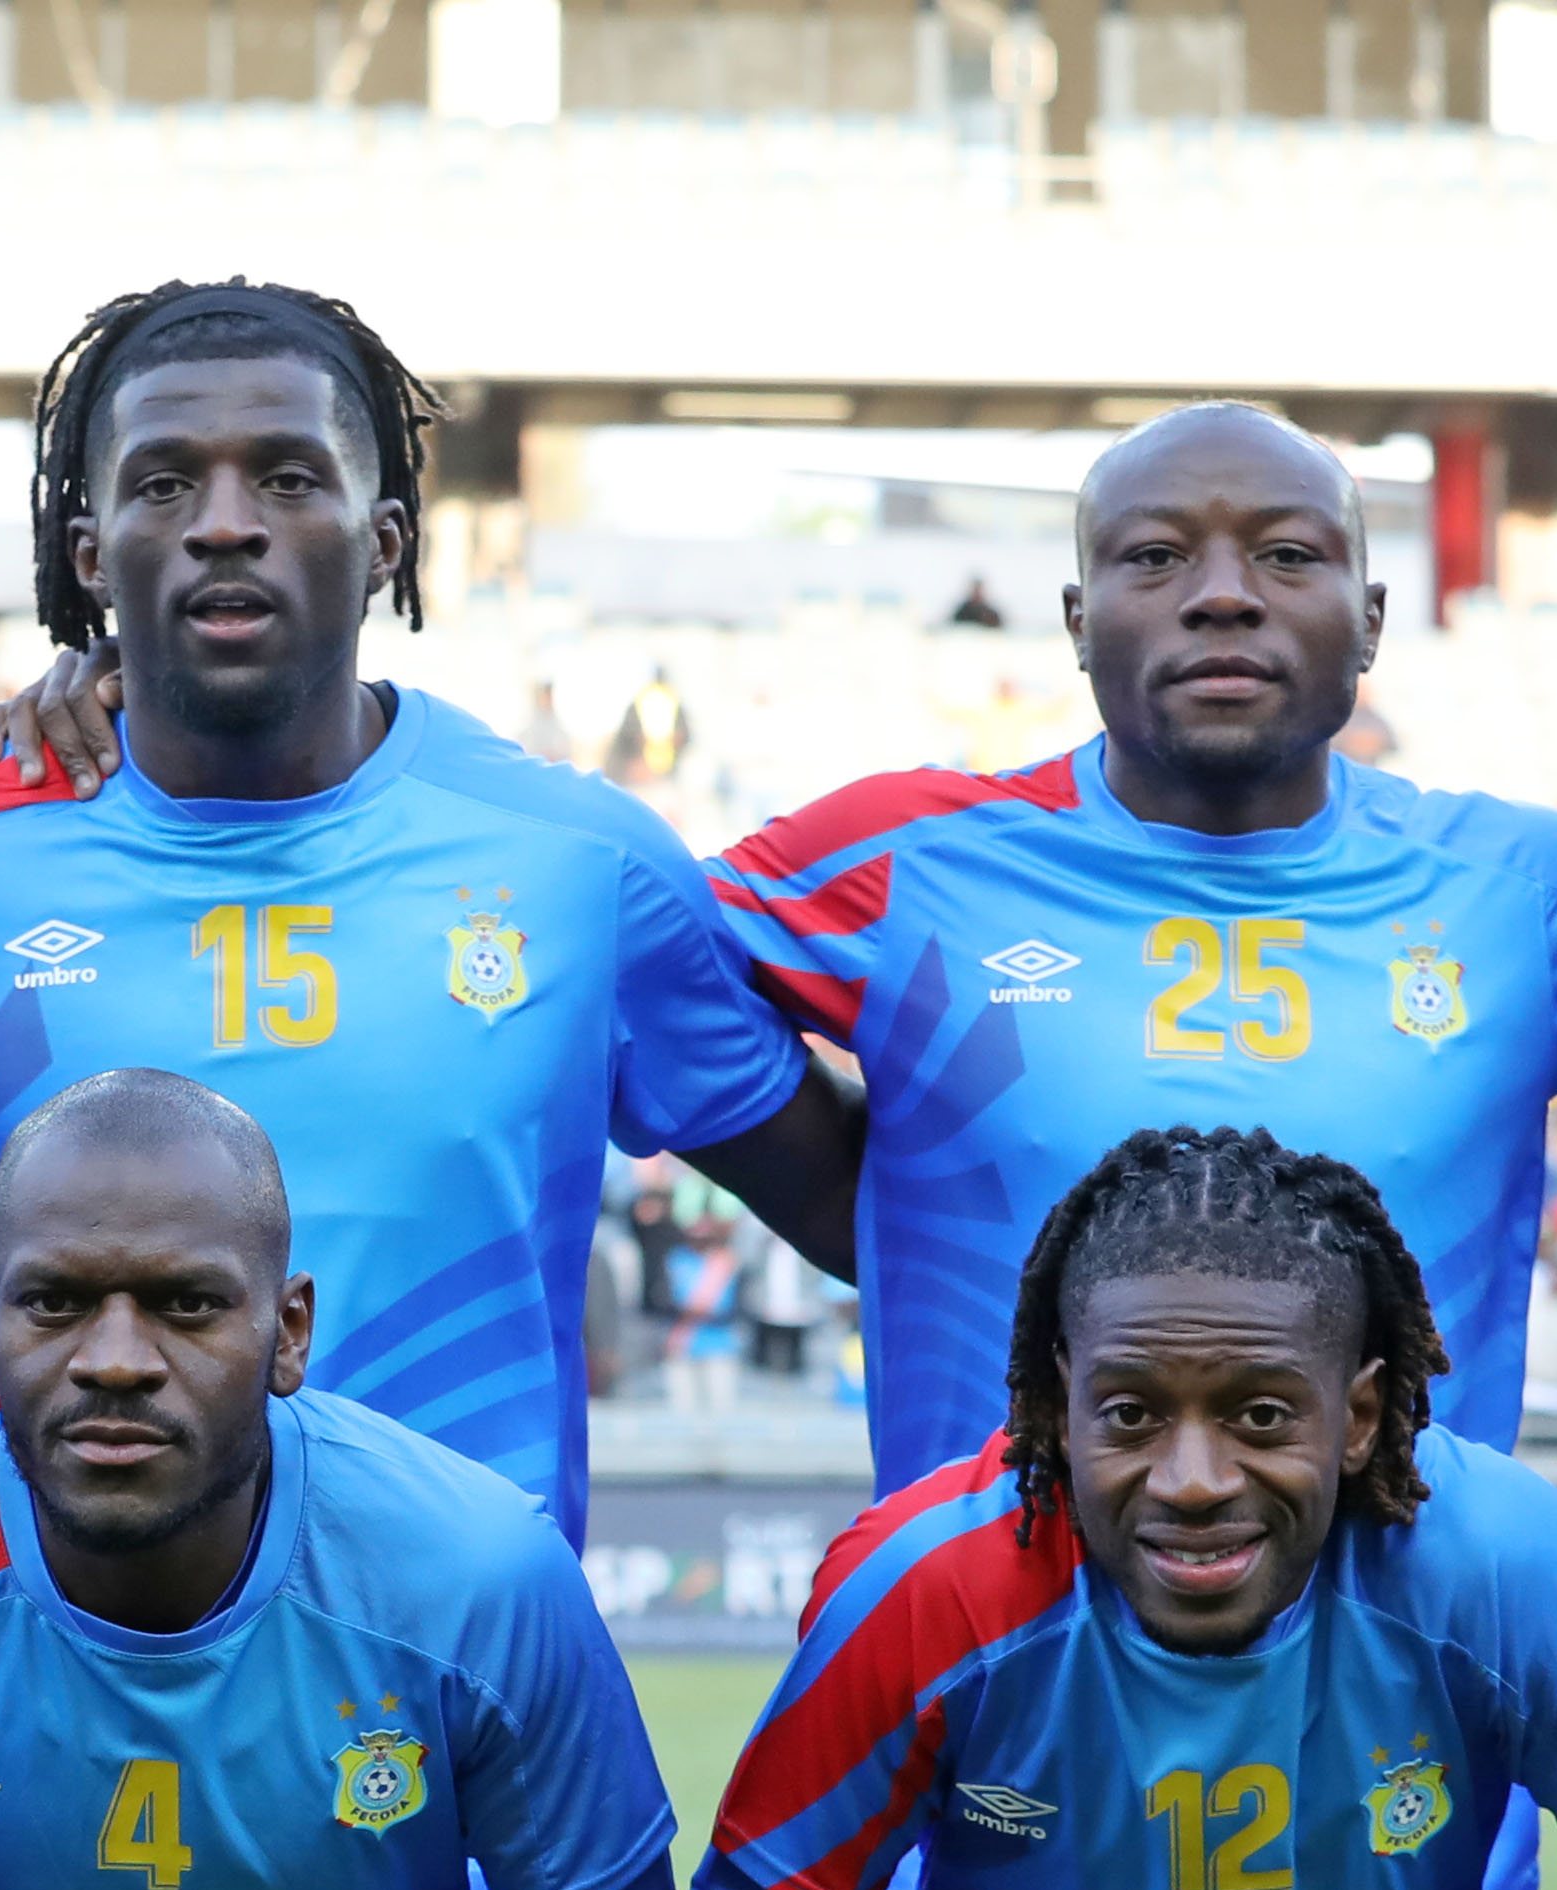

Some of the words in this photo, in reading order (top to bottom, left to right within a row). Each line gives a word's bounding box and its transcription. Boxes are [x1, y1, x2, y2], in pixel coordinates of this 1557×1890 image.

[14, 966, 98, 990] umbro
[191, 905, 338, 1049] 15
[1142, 917, 1312, 1062] 25
[461, 985, 517, 1007] FECOFA
[989, 985, 1073, 1004] umbro
[1405, 1015, 1457, 1035] FECOFA
[97, 1759, 192, 1890] 4
[351, 1799, 410, 1823] FECOFA
[964, 1810, 1047, 1840] umbro
[1387, 1813, 1438, 1848] FECOFA
